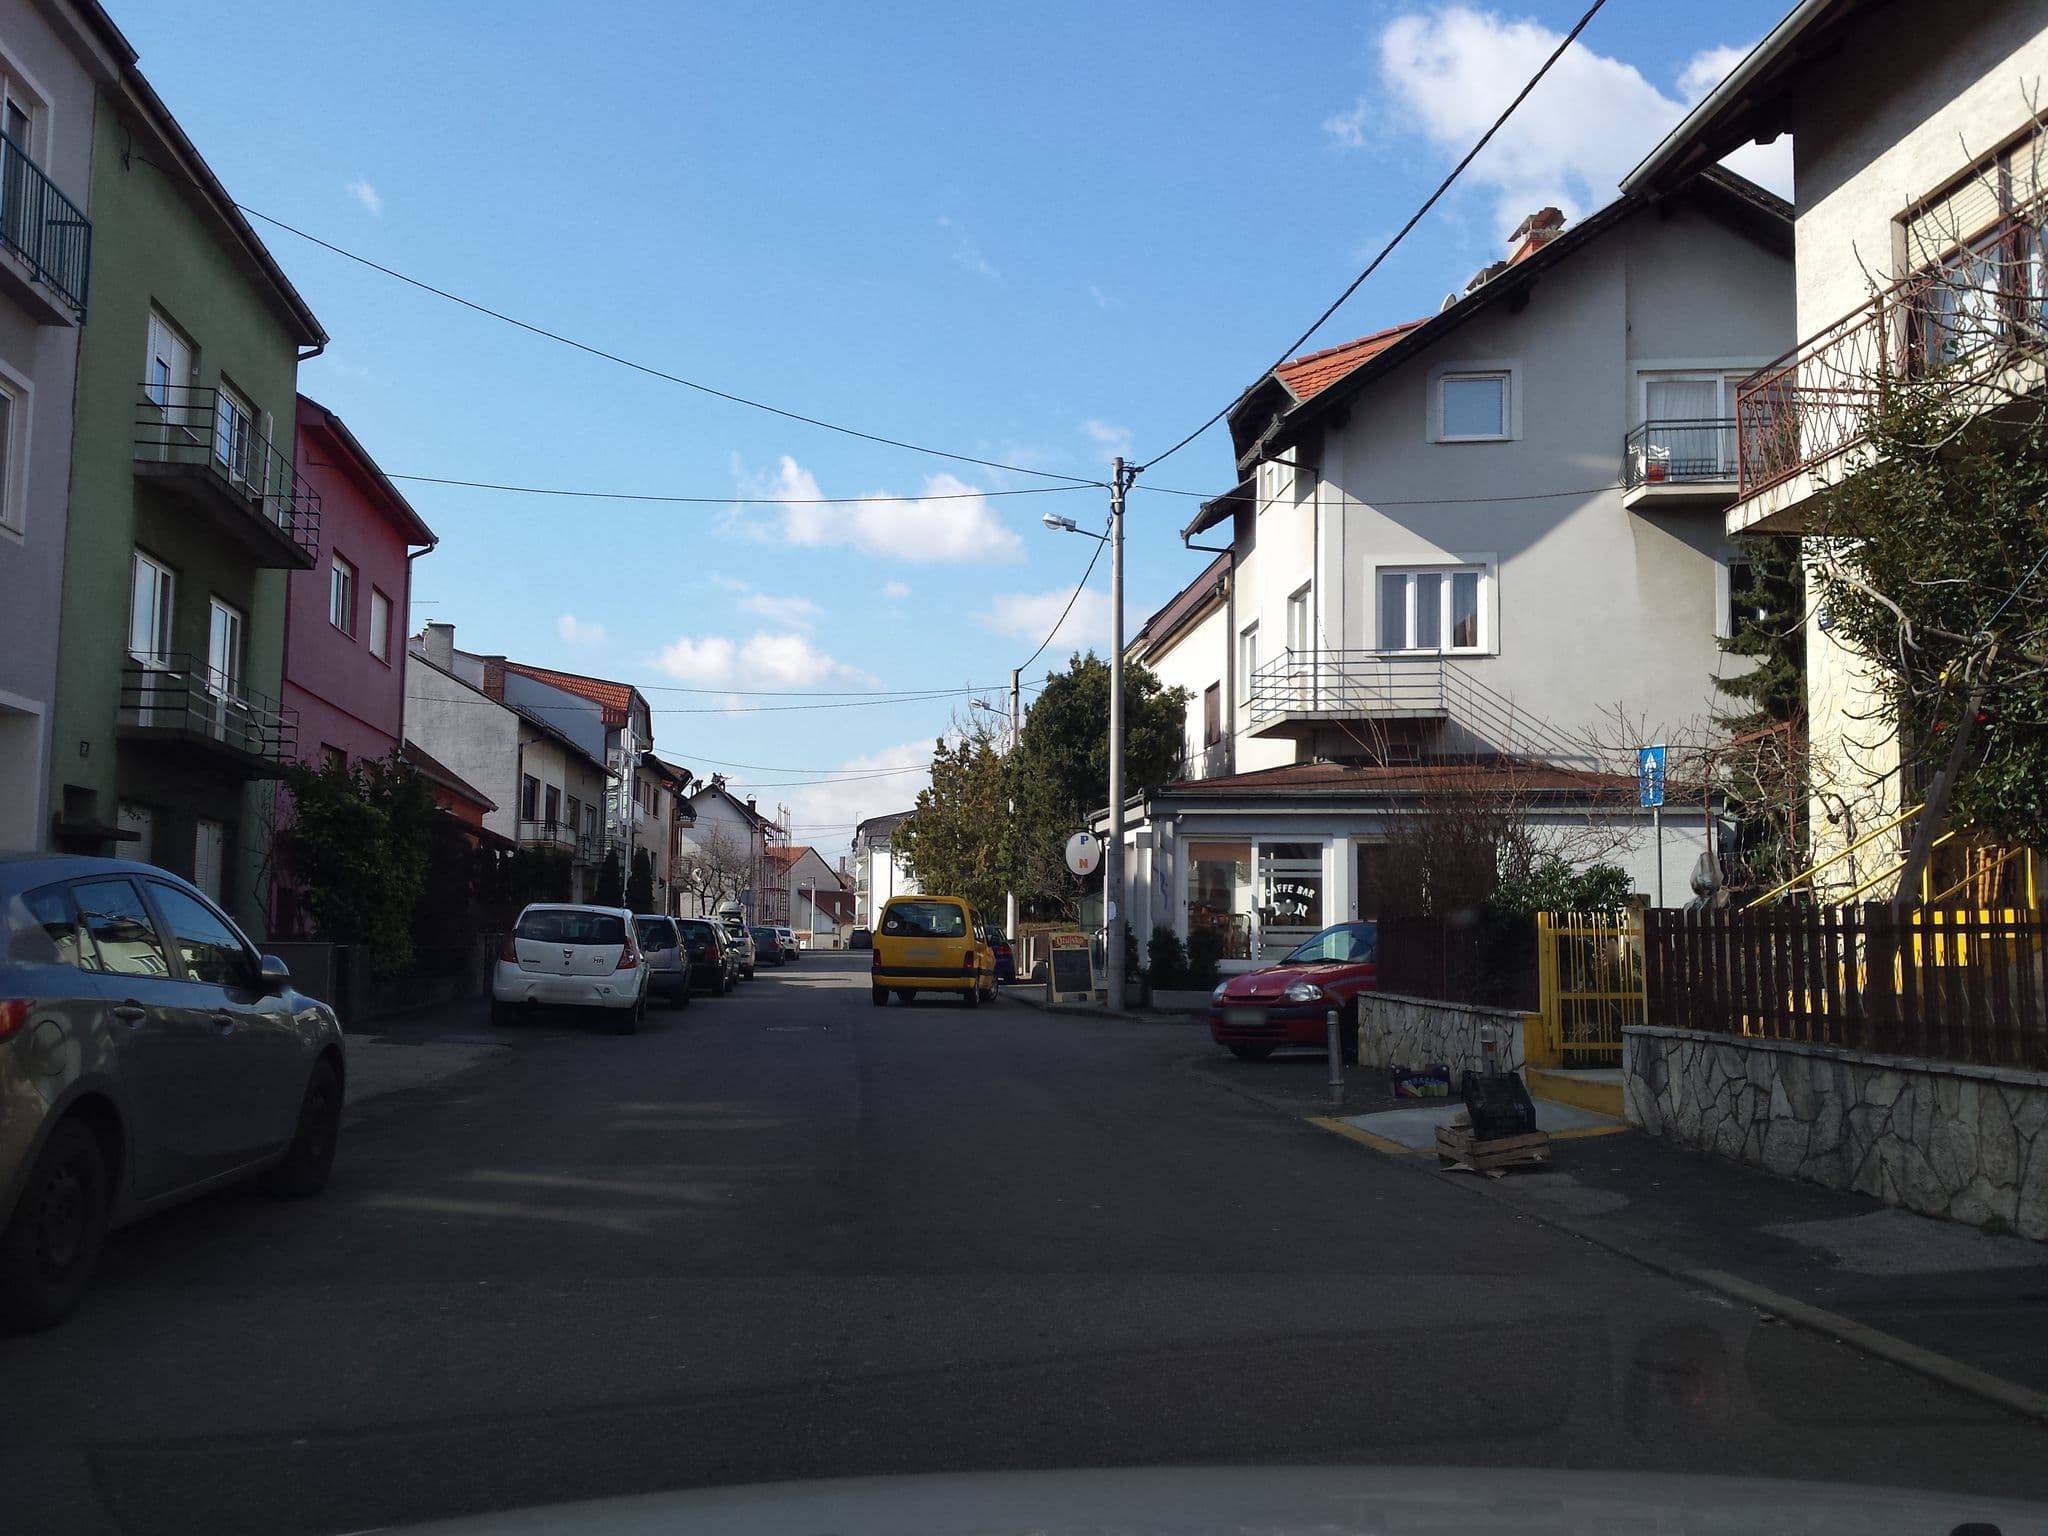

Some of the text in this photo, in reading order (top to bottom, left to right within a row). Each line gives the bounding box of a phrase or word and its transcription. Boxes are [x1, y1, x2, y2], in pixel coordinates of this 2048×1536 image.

[1265, 883, 1316, 899] CAFFE BAR
[592, 957, 604, 965] HR
